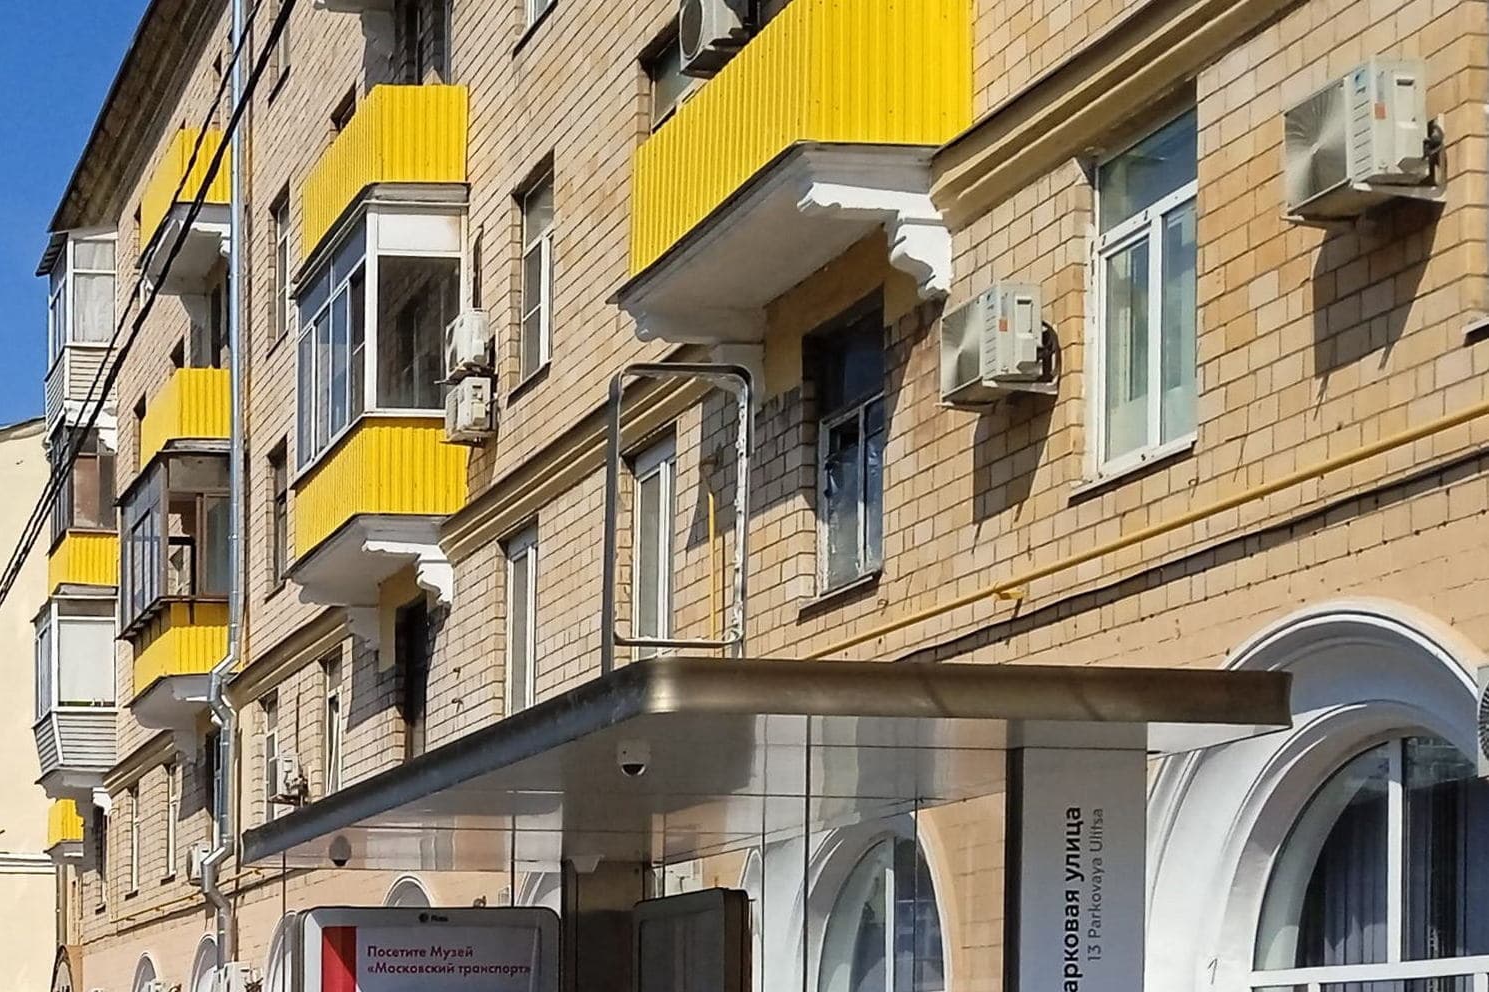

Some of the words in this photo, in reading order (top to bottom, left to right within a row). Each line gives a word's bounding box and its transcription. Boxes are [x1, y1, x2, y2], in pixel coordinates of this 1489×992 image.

[1065, 806, 1085, 882] улица
[1088, 807, 1104, 852] Ulitsa
[1087, 856, 1105, 939] Parkovaya
[366, 945, 427, 958] Посетите
[429, 945, 475, 961] Музей
[1087, 944, 1102, 961] 13
[366, 961, 455, 975] «Московский
[458, 965, 532, 978] транспорт»
